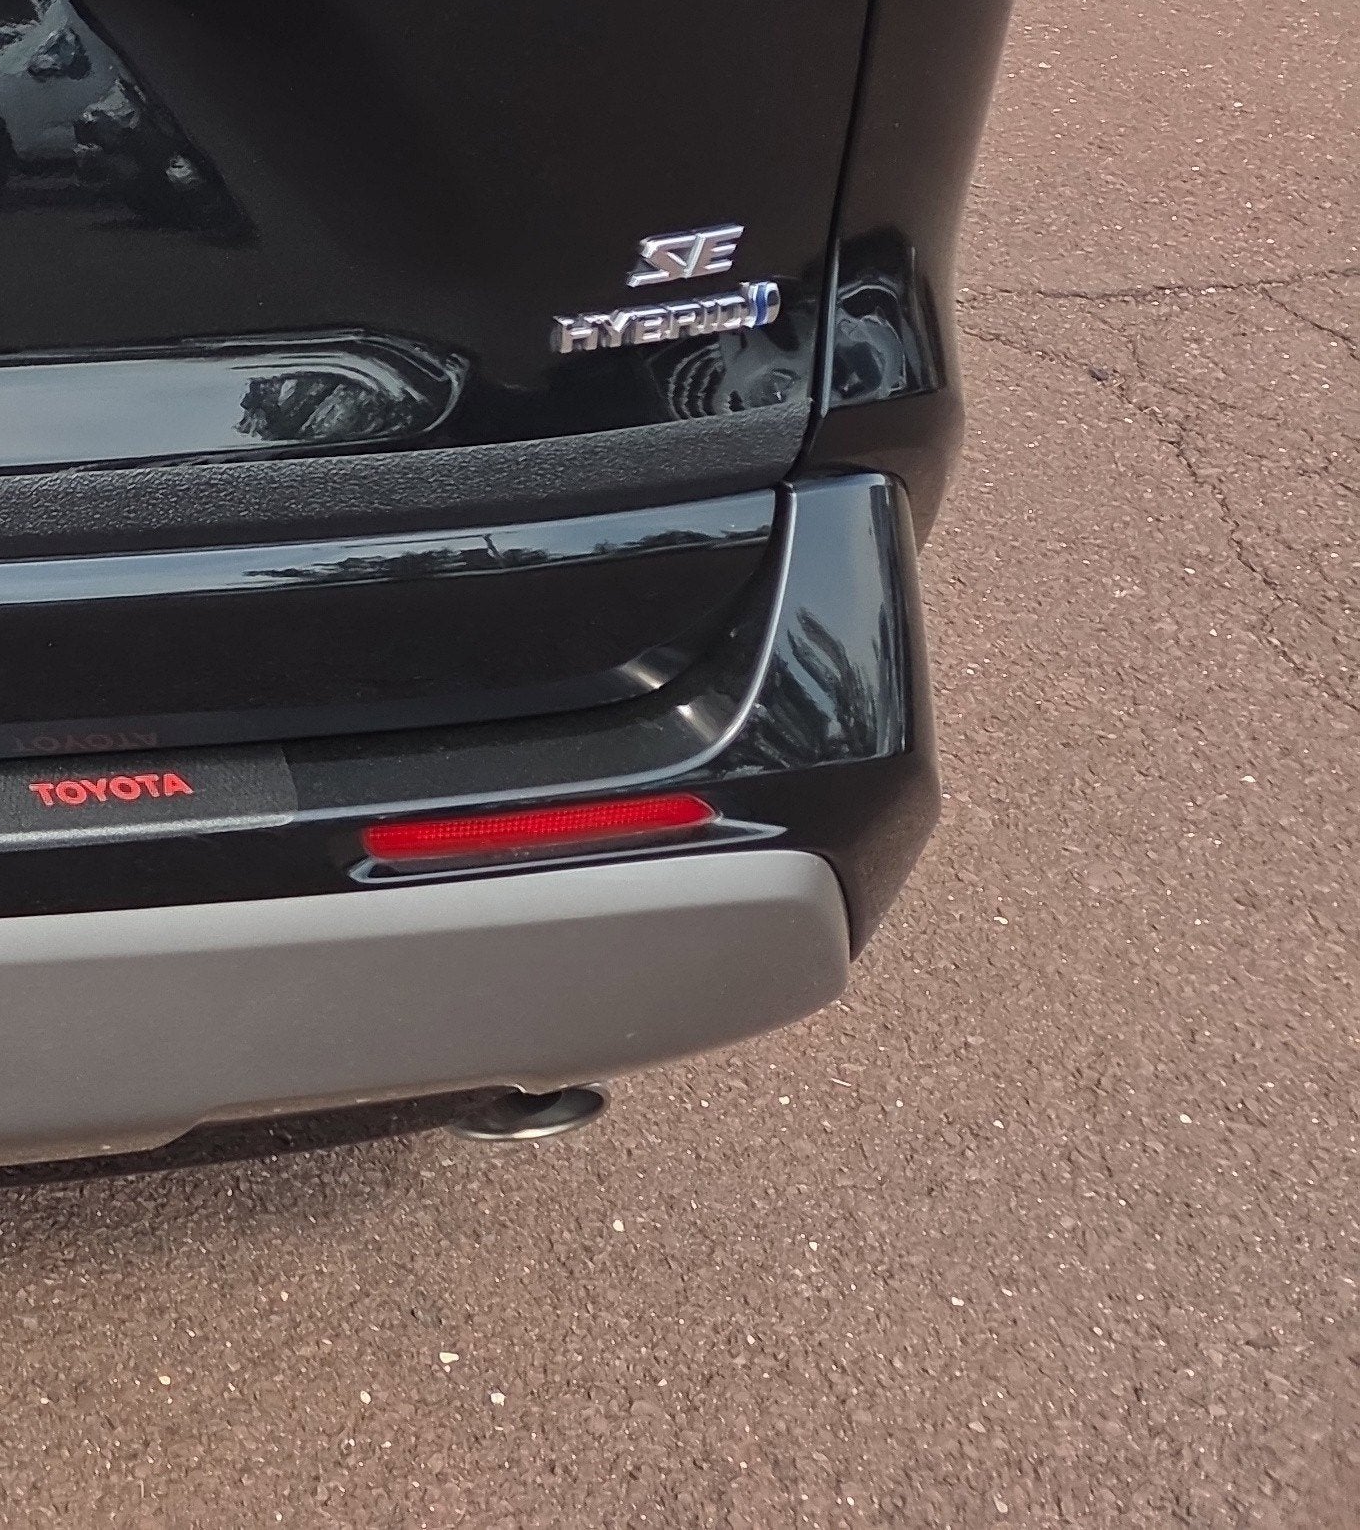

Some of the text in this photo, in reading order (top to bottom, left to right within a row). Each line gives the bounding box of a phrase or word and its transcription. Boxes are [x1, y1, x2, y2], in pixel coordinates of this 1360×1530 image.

[626, 224, 745, 288] SE
[552, 291, 753, 353] HYBRID
[28, 773, 194, 806] TOYOTA
